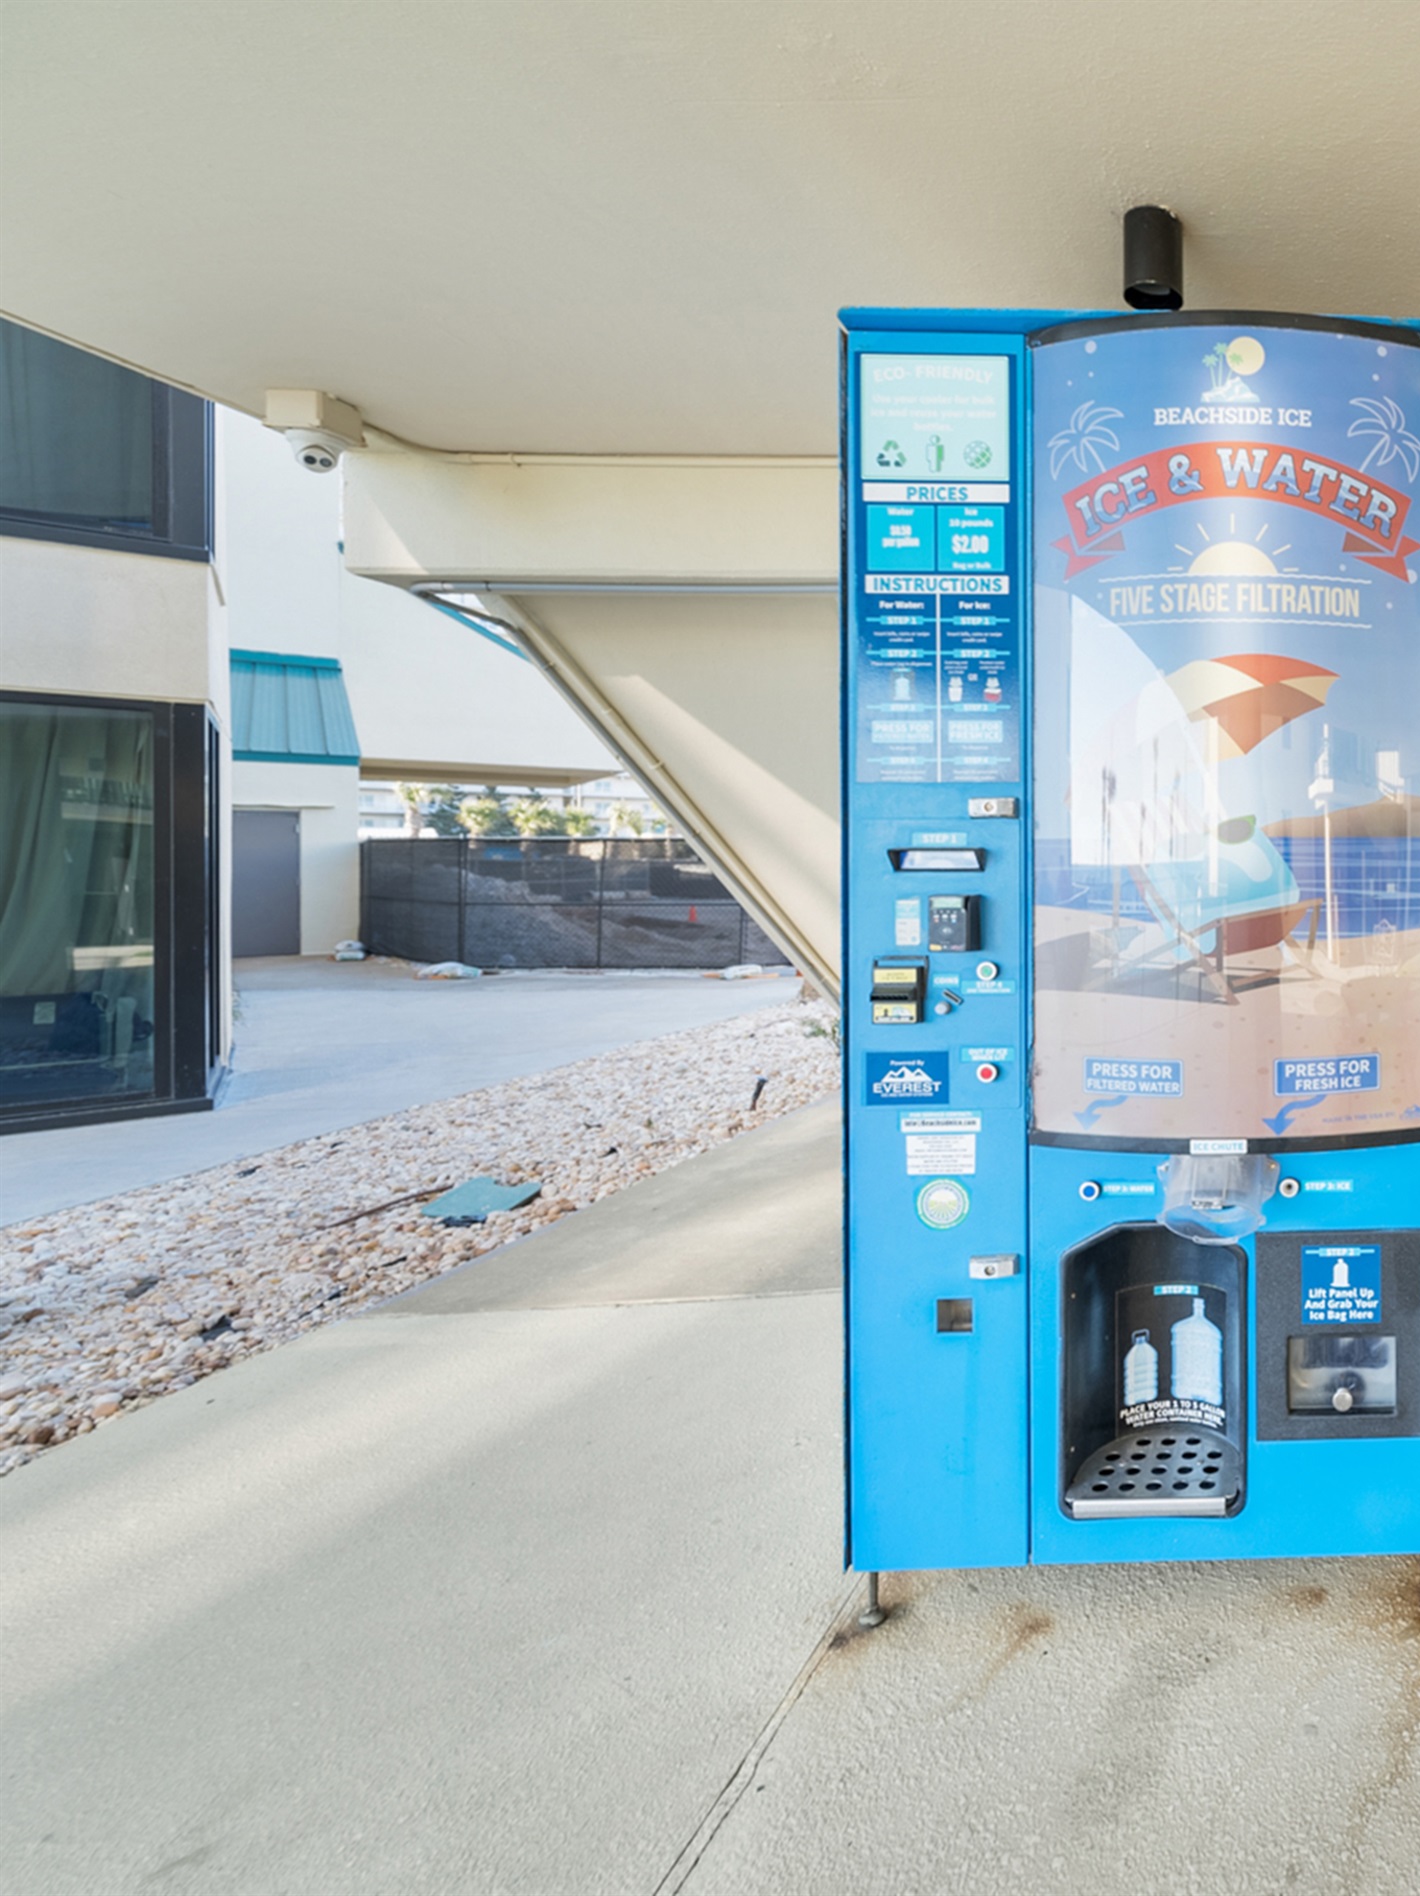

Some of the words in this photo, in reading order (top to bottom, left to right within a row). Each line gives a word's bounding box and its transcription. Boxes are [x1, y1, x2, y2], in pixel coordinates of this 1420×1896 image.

[872, 366, 911, 383] ECO-
[915, 365, 993, 384] FRIENDLY
[1154, 407, 1272, 426] BEACHSIDE
[1277, 408, 1312, 427] ICE
[906, 486, 969, 500] PRICES
[1075, 465, 1157, 537] ICE
[1168, 454, 1204, 495] &
[1216, 448, 1398, 538] WATER
[886, 507, 914, 516] Water
[963, 507, 978, 516] Ice
[961, 519, 994, 528] pounds
[952, 534, 989, 554] $2.00
[873, 577, 1003, 592] INSTRUCTIONS
[878, 600, 893, 609] For
[958, 601, 974, 610] For
[1110, 586, 1154, 616] FIVE
[1160, 584, 1229, 612] STAGE
[1236, 583, 1360, 618] FILTRATION
[886, 616, 909, 625] STEP
[960, 617, 983, 625] STEP
[887, 649, 909, 658] STEP
[960, 649, 983, 658] STEP
[922, 834, 947, 844] STEP
[1092, 1062, 1138, 1078] PRESS
[1140, 1063, 1172, 1080] FOR
[1285, 1063, 1335, 1078] PRESS
[1336, 1060, 1370, 1075] FOR
[872, 1082, 942, 1094] EVEREST
[1087, 1079, 1136, 1092] FILTERED
[1138, 1082, 1180, 1093] WATER
[1295, 1077, 1338, 1090] FRESH
[1340, 1076, 1362, 1088] ICE
[1194, 1143, 1208, 1151] ICE
[1211, 1142, 1244, 1150] CHUTE
[1305, 1183, 1327, 1191] STEP
[1336, 1182, 1351, 1191] ICE
[1326, 1248, 1348, 1257] STEP
[1162, 1286, 1184, 1294] STEP
[1308, 1288, 1326, 1298] Lift
[1329, 1288, 1358, 1298] Panel
[1360, 1288, 1374, 1300] Up
[1304, 1300, 1325, 1310] And
[1328, 1300, 1352, 1309] Grab
[1354, 1299, 1379, 1308] Your
[1309, 1311, 1325, 1320] Ice
[1327, 1311, 1347, 1322] Bag
[1349, 1310, 1374, 1320] Here
[1120, 1404, 1146, 1419] PLACE
[1148, 1400, 1171, 1410] YOUR
[1180, 1400, 1191, 1408] TO
[1200, 1402, 1226, 1419] GALLON
[1126, 1411, 1154, 1426] WATER
[1156, 1409, 1202, 1418] CONTAINER
